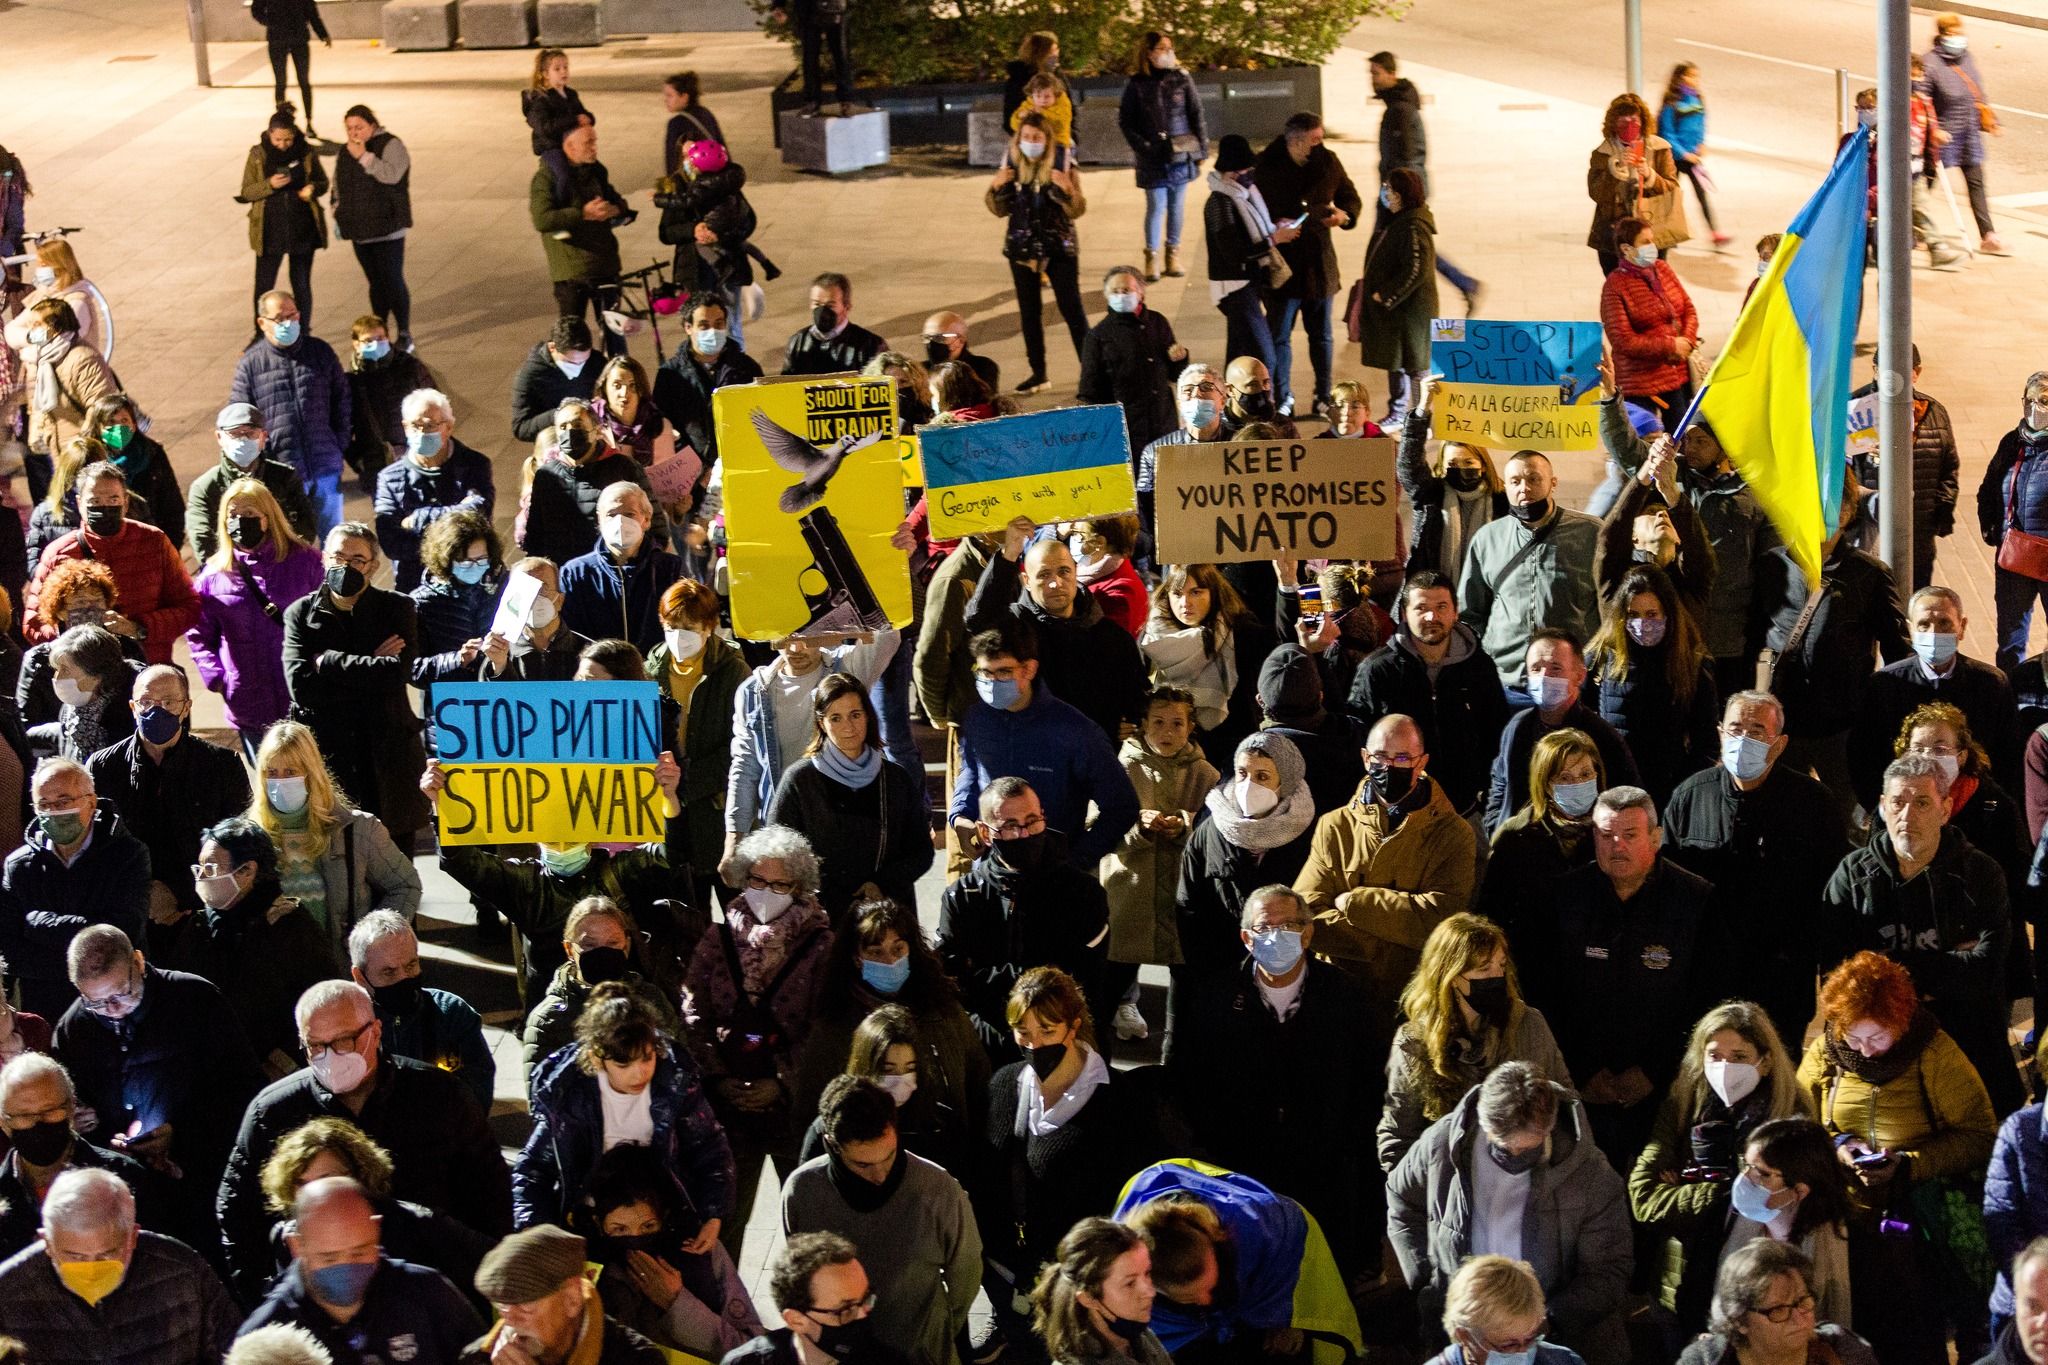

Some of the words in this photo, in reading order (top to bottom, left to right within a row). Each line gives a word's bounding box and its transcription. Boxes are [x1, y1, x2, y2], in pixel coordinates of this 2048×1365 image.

[1472, 323, 1556, 355] STOP
[805, 388, 855, 411] SHOUT
[861, 385, 890, 404] FOR
[1449, 393, 1466, 409] NO
[1467, 395, 1478, 411] A
[1481, 395, 1497, 412] LA
[1501, 396, 1560, 413] GUERRA
[808, 415, 892, 441] UKRAINE
[1446, 414, 1475, 432] PAZ
[1481, 420, 1491, 435] A
[1502, 419, 1593, 438] UCRAINA
[1223, 444, 1307, 475] KEEP
[941, 490, 1001, 517] Georgia
[1012, 491, 1023, 502] is
[1032, 485, 1056, 499] with
[1177, 482, 1245, 510] YOUR
[1252, 480, 1387, 508] PROMISES
[1215, 511, 1338, 555] NATO
[435, 697, 538, 760] STOP
[444, 767, 550, 835] STOP
[561, 766, 663, 837] WAR
